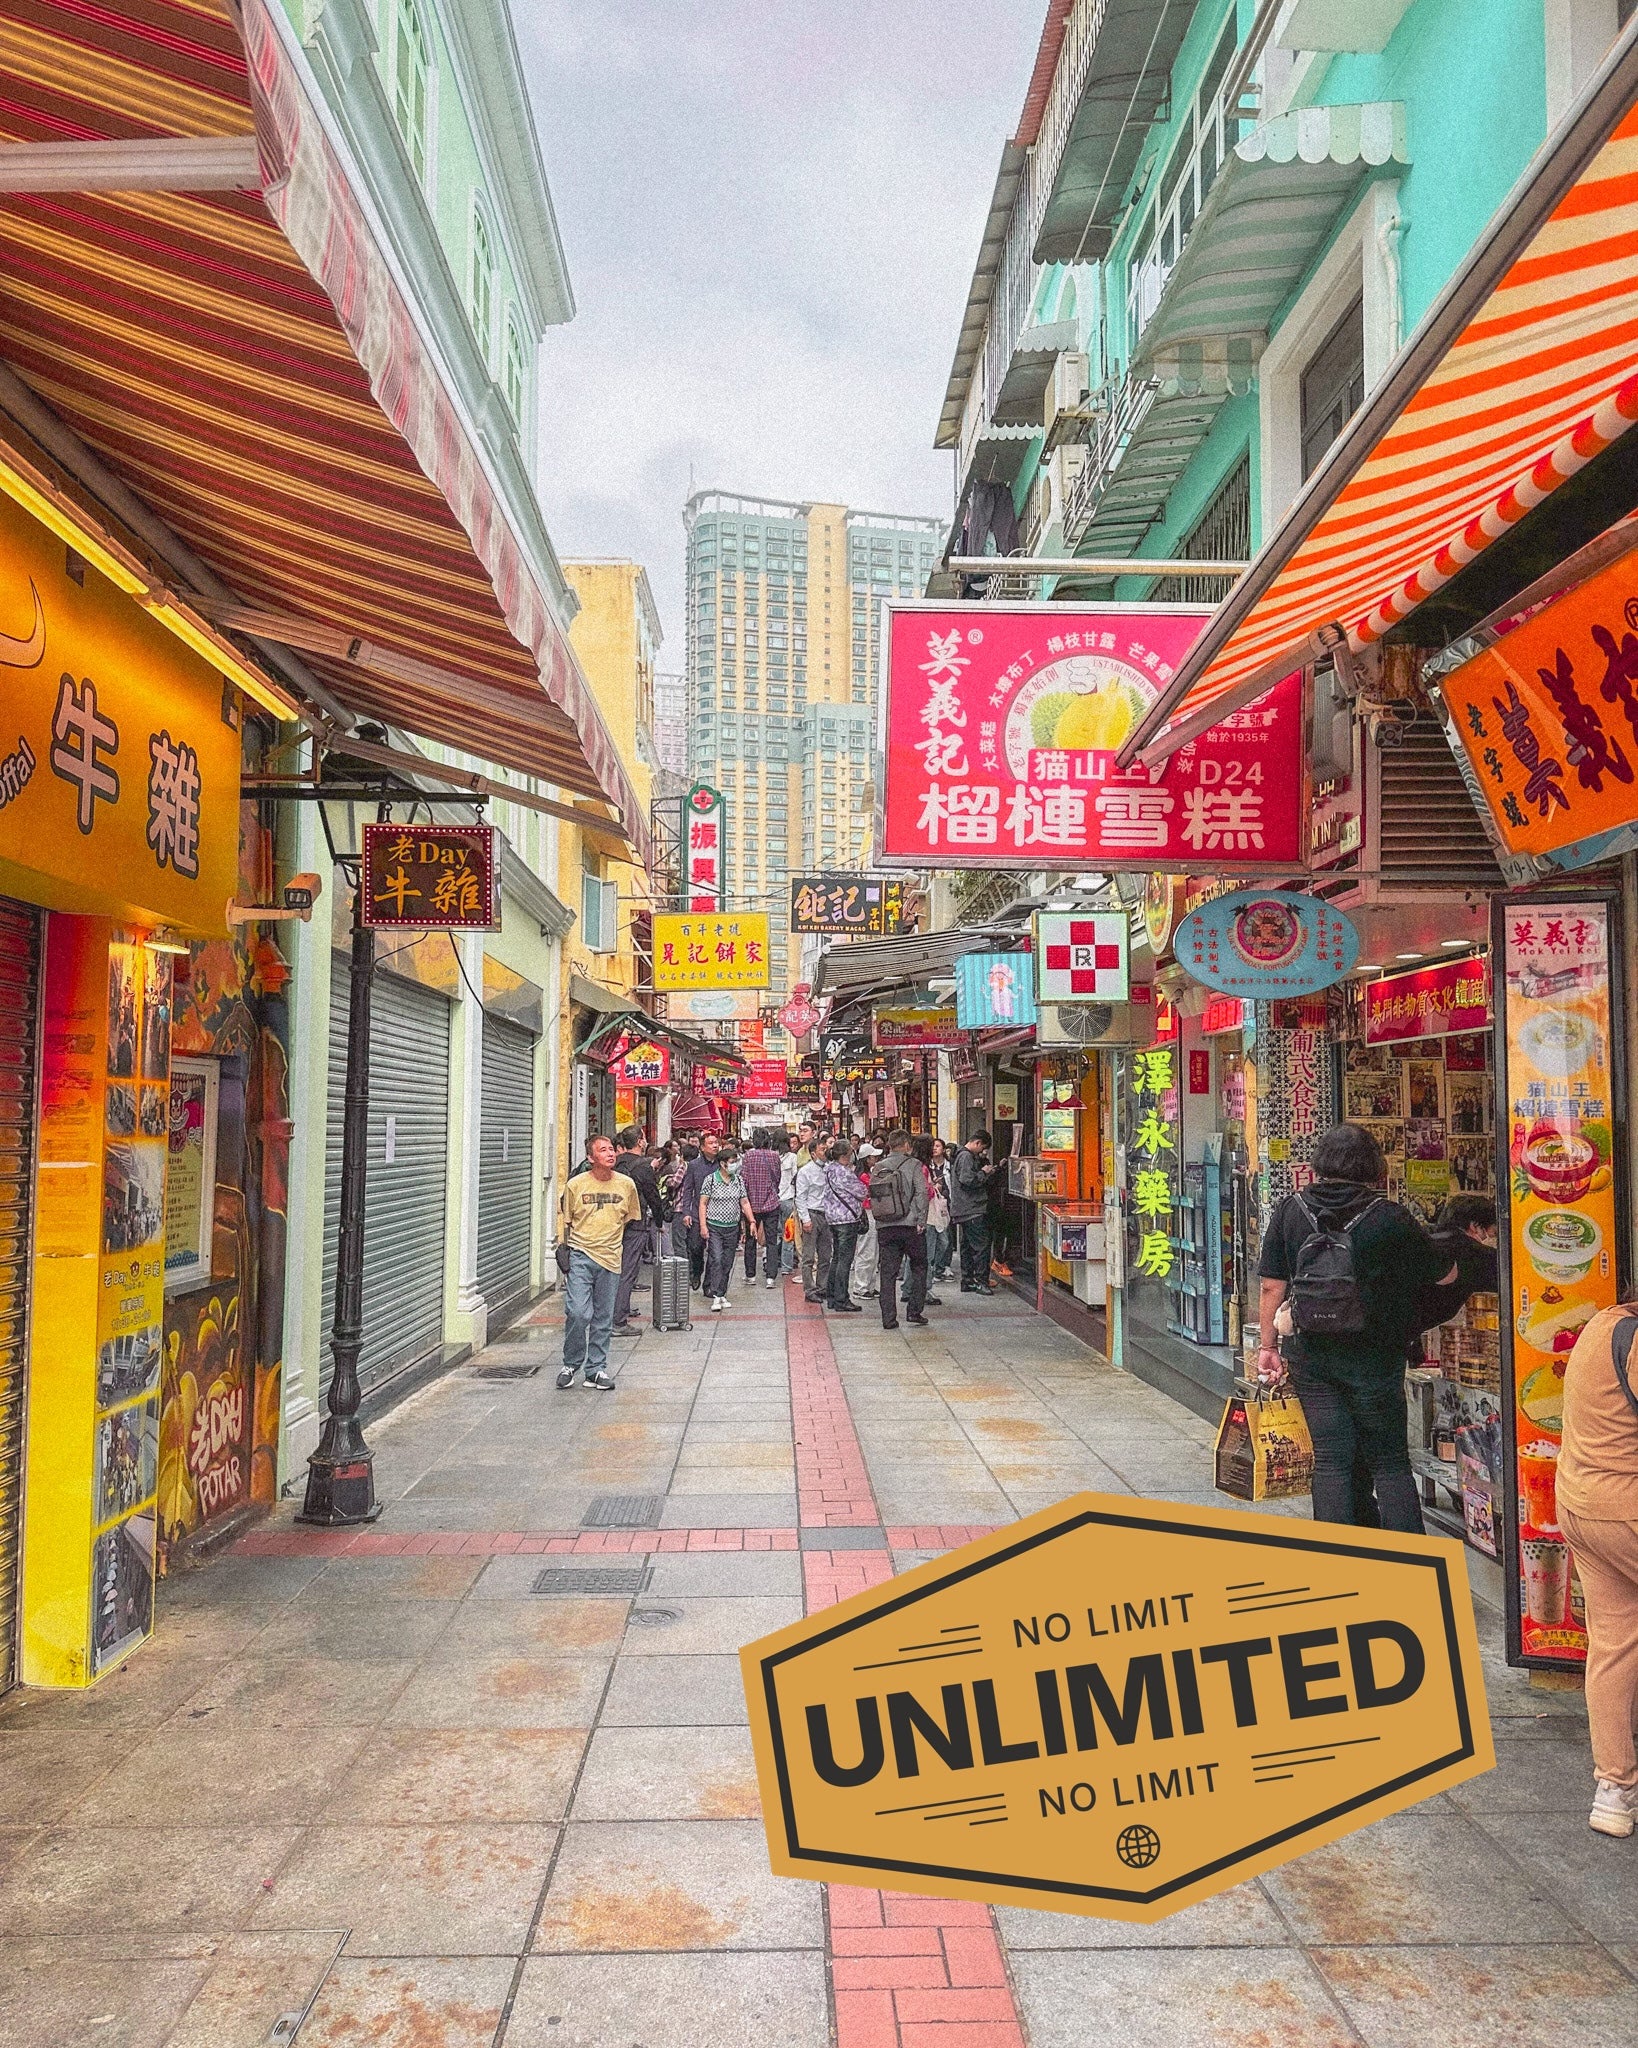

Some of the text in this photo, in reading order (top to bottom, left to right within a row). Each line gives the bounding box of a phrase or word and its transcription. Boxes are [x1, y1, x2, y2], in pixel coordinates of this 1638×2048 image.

[1046, 630, 1117, 654] 楊枝甘露
[914, 627, 971, 777] 莫義記
[1206, 732, 1270, 744] 始於1935年
[51, 672, 201, 880] 牛雜
[1200, 759, 1265, 786] D24
[915, 783, 1265, 851] 榴槤雪糕
[373, 866, 483, 919] 牛雜
[794, 884, 866, 924] 鉅記
[1510, 919, 1601, 946] 莫義記
[1518, 947, 1544, 956] Mok
[1551, 947, 1571, 955] Yei
[660, 941, 764, 966] 晃記餅家
[1288, 1031, 1316, 1135] 葡式食品
[1132, 1050, 1175, 1278] 澤永藥房
